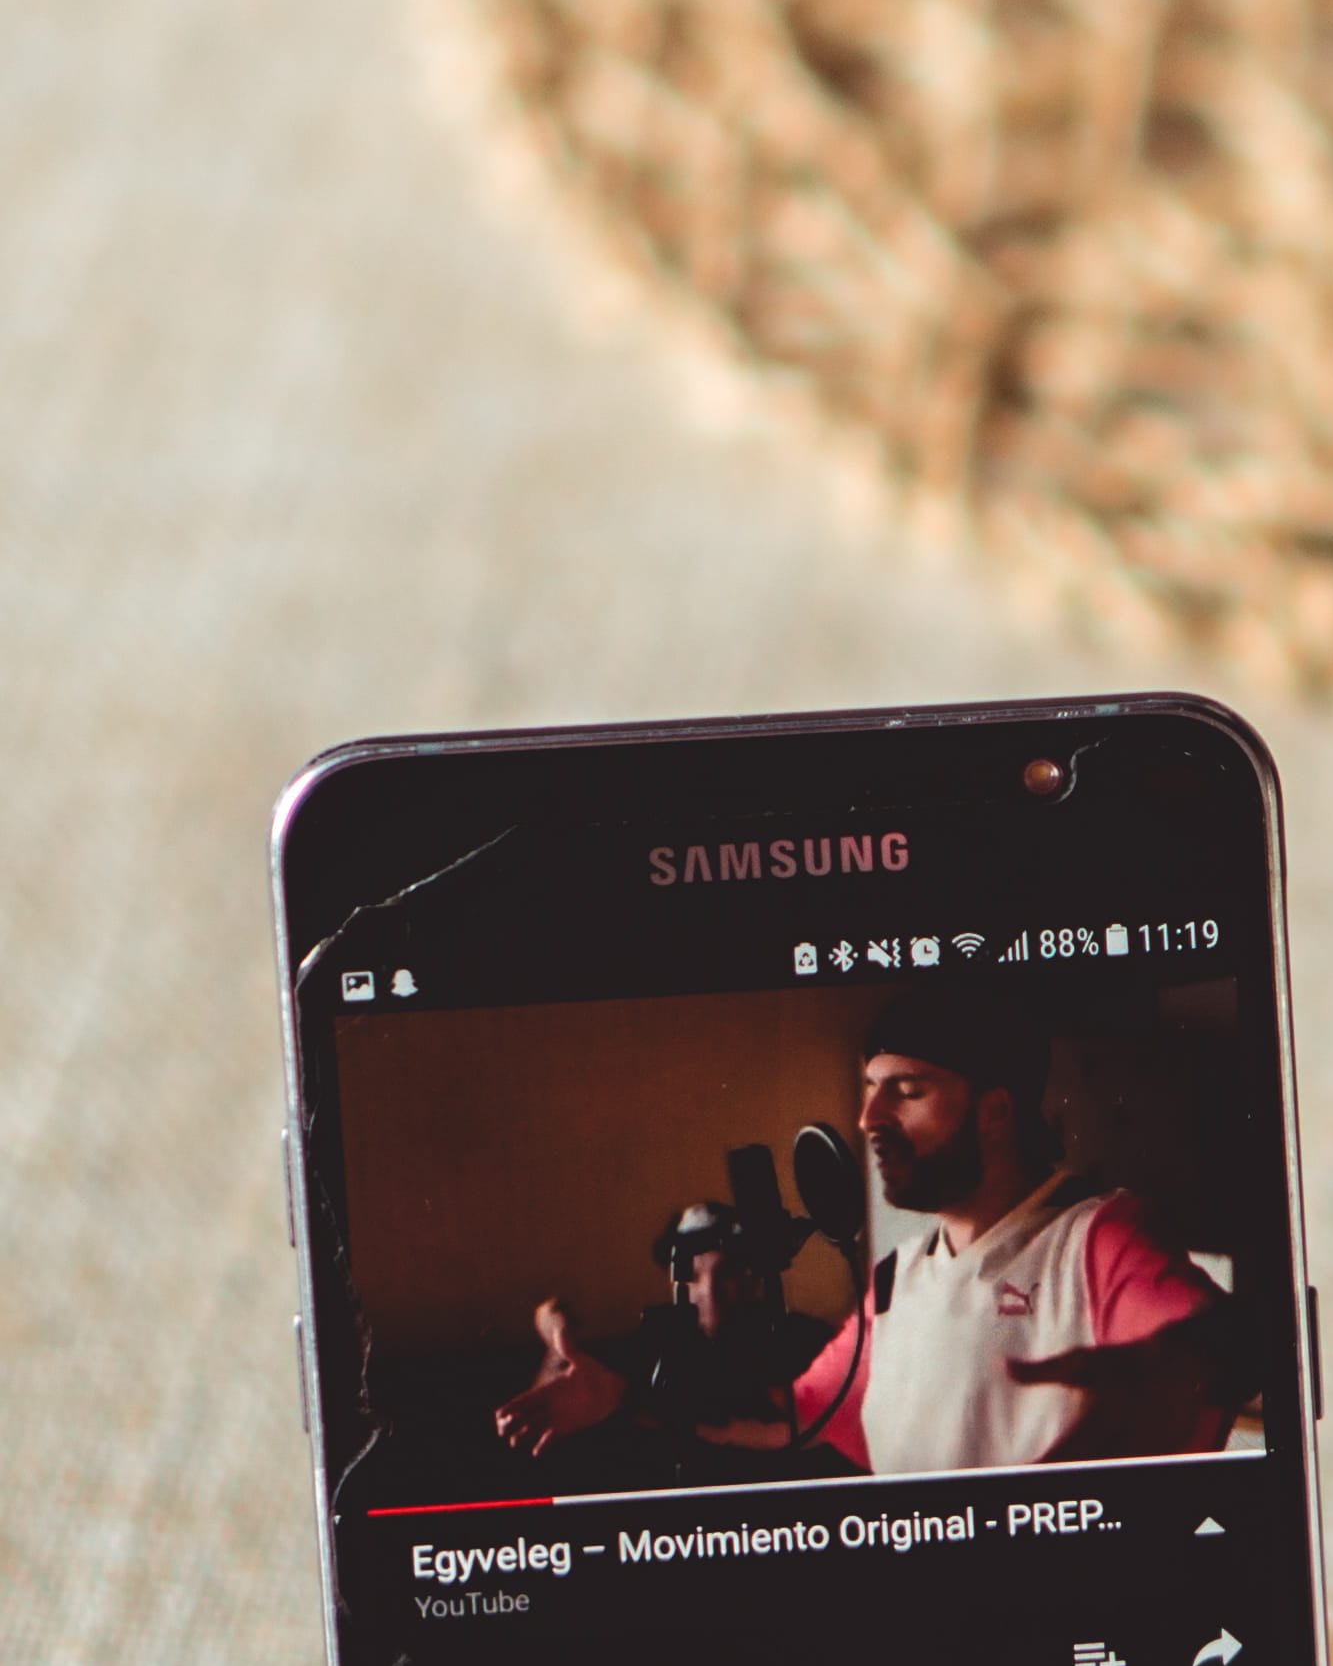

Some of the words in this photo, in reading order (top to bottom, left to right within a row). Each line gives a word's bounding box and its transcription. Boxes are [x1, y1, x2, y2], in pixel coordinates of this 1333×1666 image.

[650, 832, 909, 886] SAMSUNG
[1039, 927, 1100, 959] 88%
[1137, 919, 1221, 955] 11:19
[412, 1536, 572, 1584] Egyveleg
[618, 1521, 830, 1563] Movimiento
[839, 1506, 975, 1552] Original
[414, 1589, 530, 1619] YouTube
